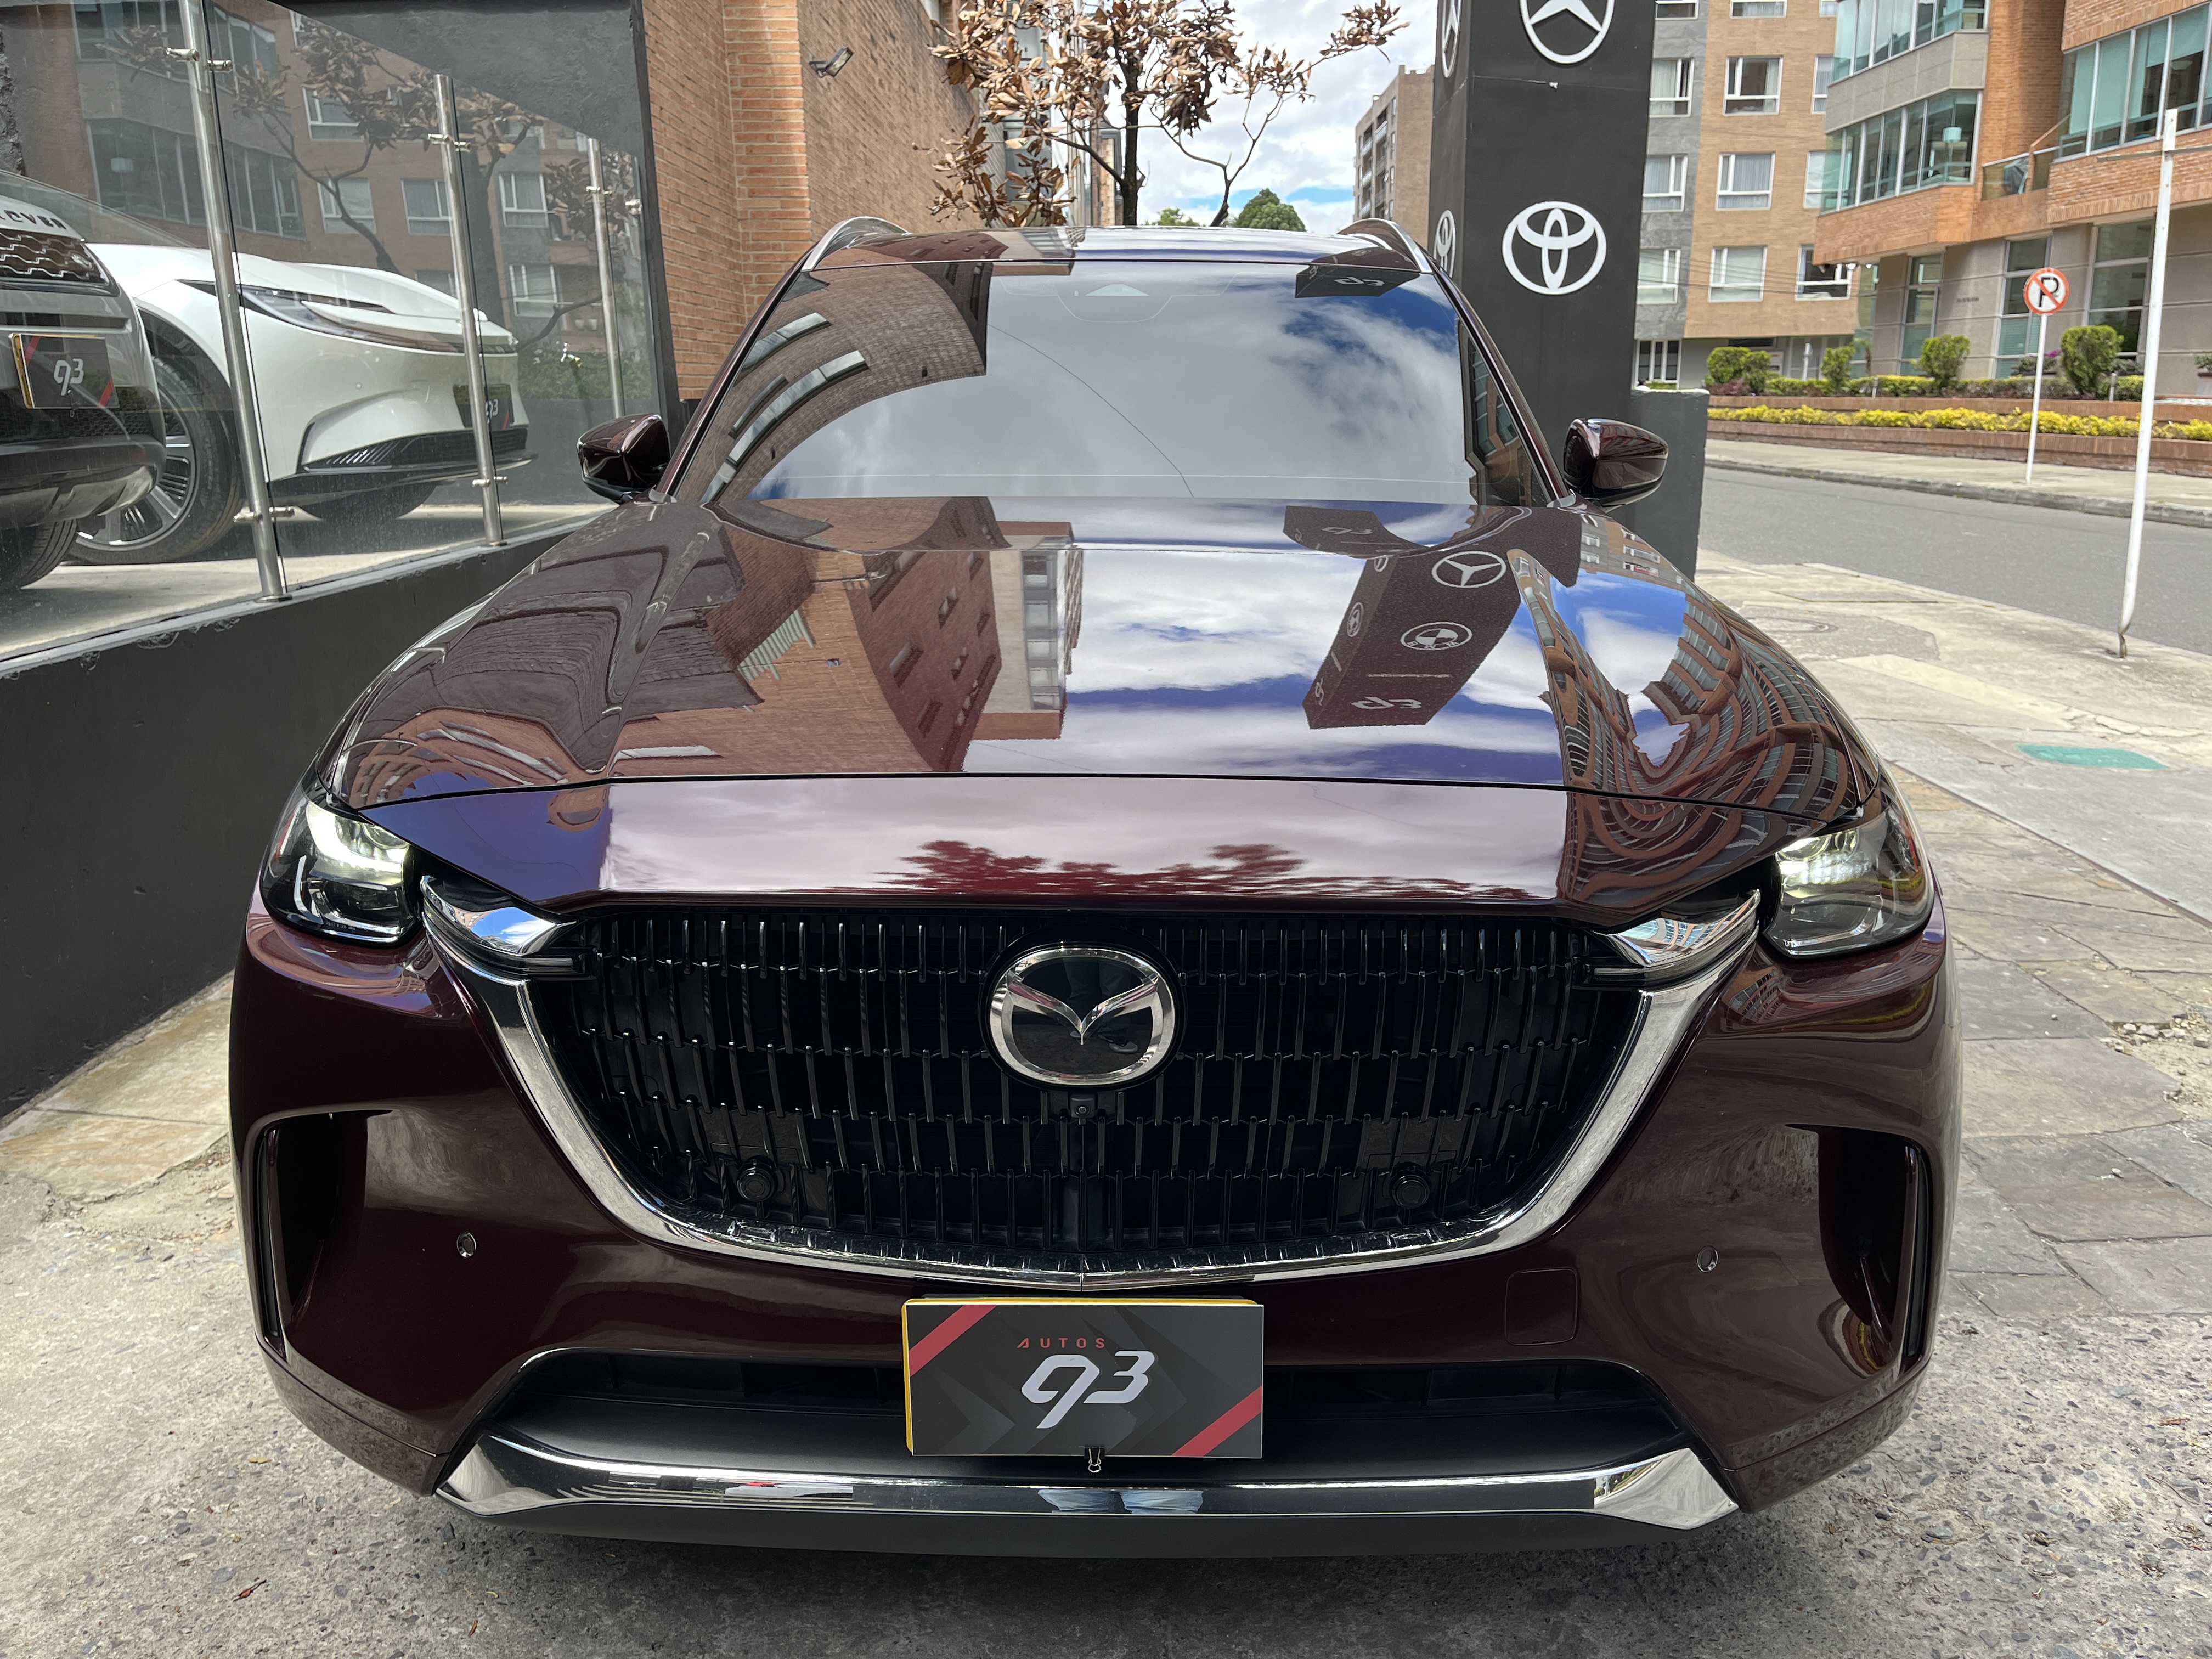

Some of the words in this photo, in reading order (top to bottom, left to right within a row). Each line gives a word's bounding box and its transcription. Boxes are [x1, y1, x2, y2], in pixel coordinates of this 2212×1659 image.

[0, 210, 66, 229] OVER
[53, 358, 84, 396] 93
[1016, 1337, 1106, 1349] AUTOS
[1021, 1350, 1155, 1429] 93
